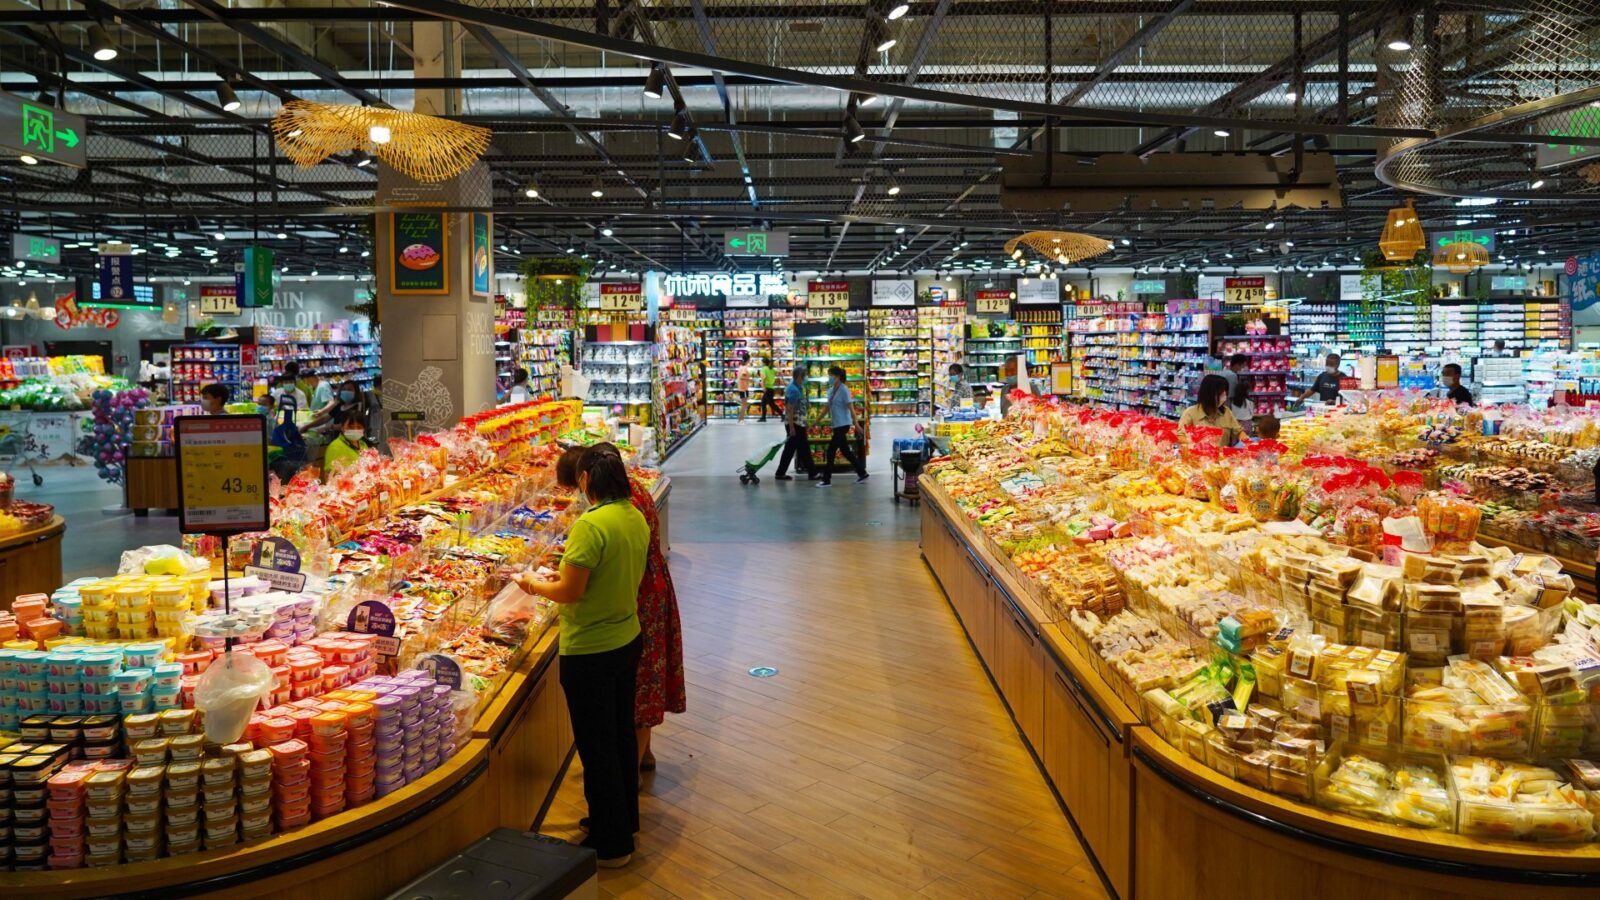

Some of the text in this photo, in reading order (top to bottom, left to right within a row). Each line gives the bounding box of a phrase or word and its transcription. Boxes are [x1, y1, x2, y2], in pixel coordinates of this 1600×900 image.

[663, 273, 757, 296] 休闲食品
[466, 311, 492, 334] SNACK
[470, 333, 496, 355] FOODS
[221, 477, 258, 494] 43 80
